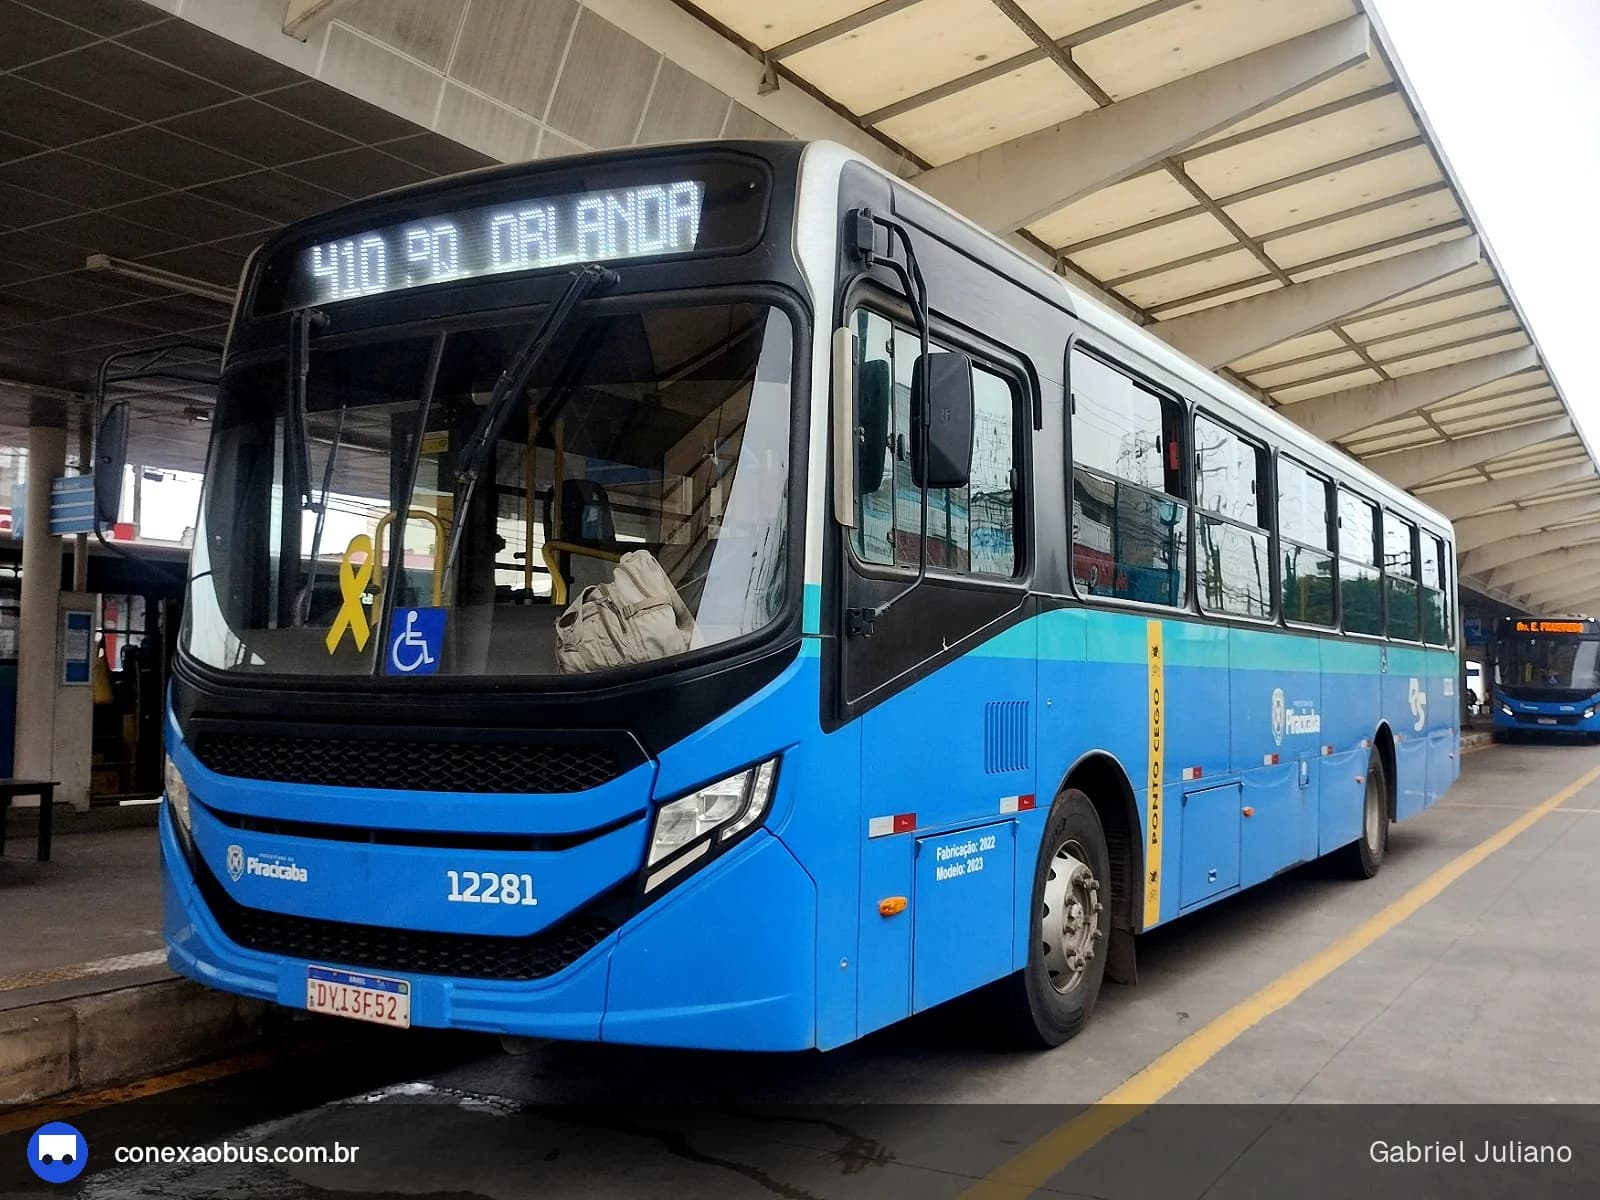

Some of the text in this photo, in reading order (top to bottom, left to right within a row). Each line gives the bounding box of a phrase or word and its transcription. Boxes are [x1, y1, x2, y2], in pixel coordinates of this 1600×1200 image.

[311, 235, 388, 299] 410
[1151, 687, 1160, 845] PONTO CEGO
[936, 835, 996, 862] Fabricação: 2022
[247, 856, 308, 882] Piracicaba
[936, 856, 984, 881] Modelo: 2023
[447, 870, 537, 905] 12281
[317, 983, 397, 1020] DYI3F52
